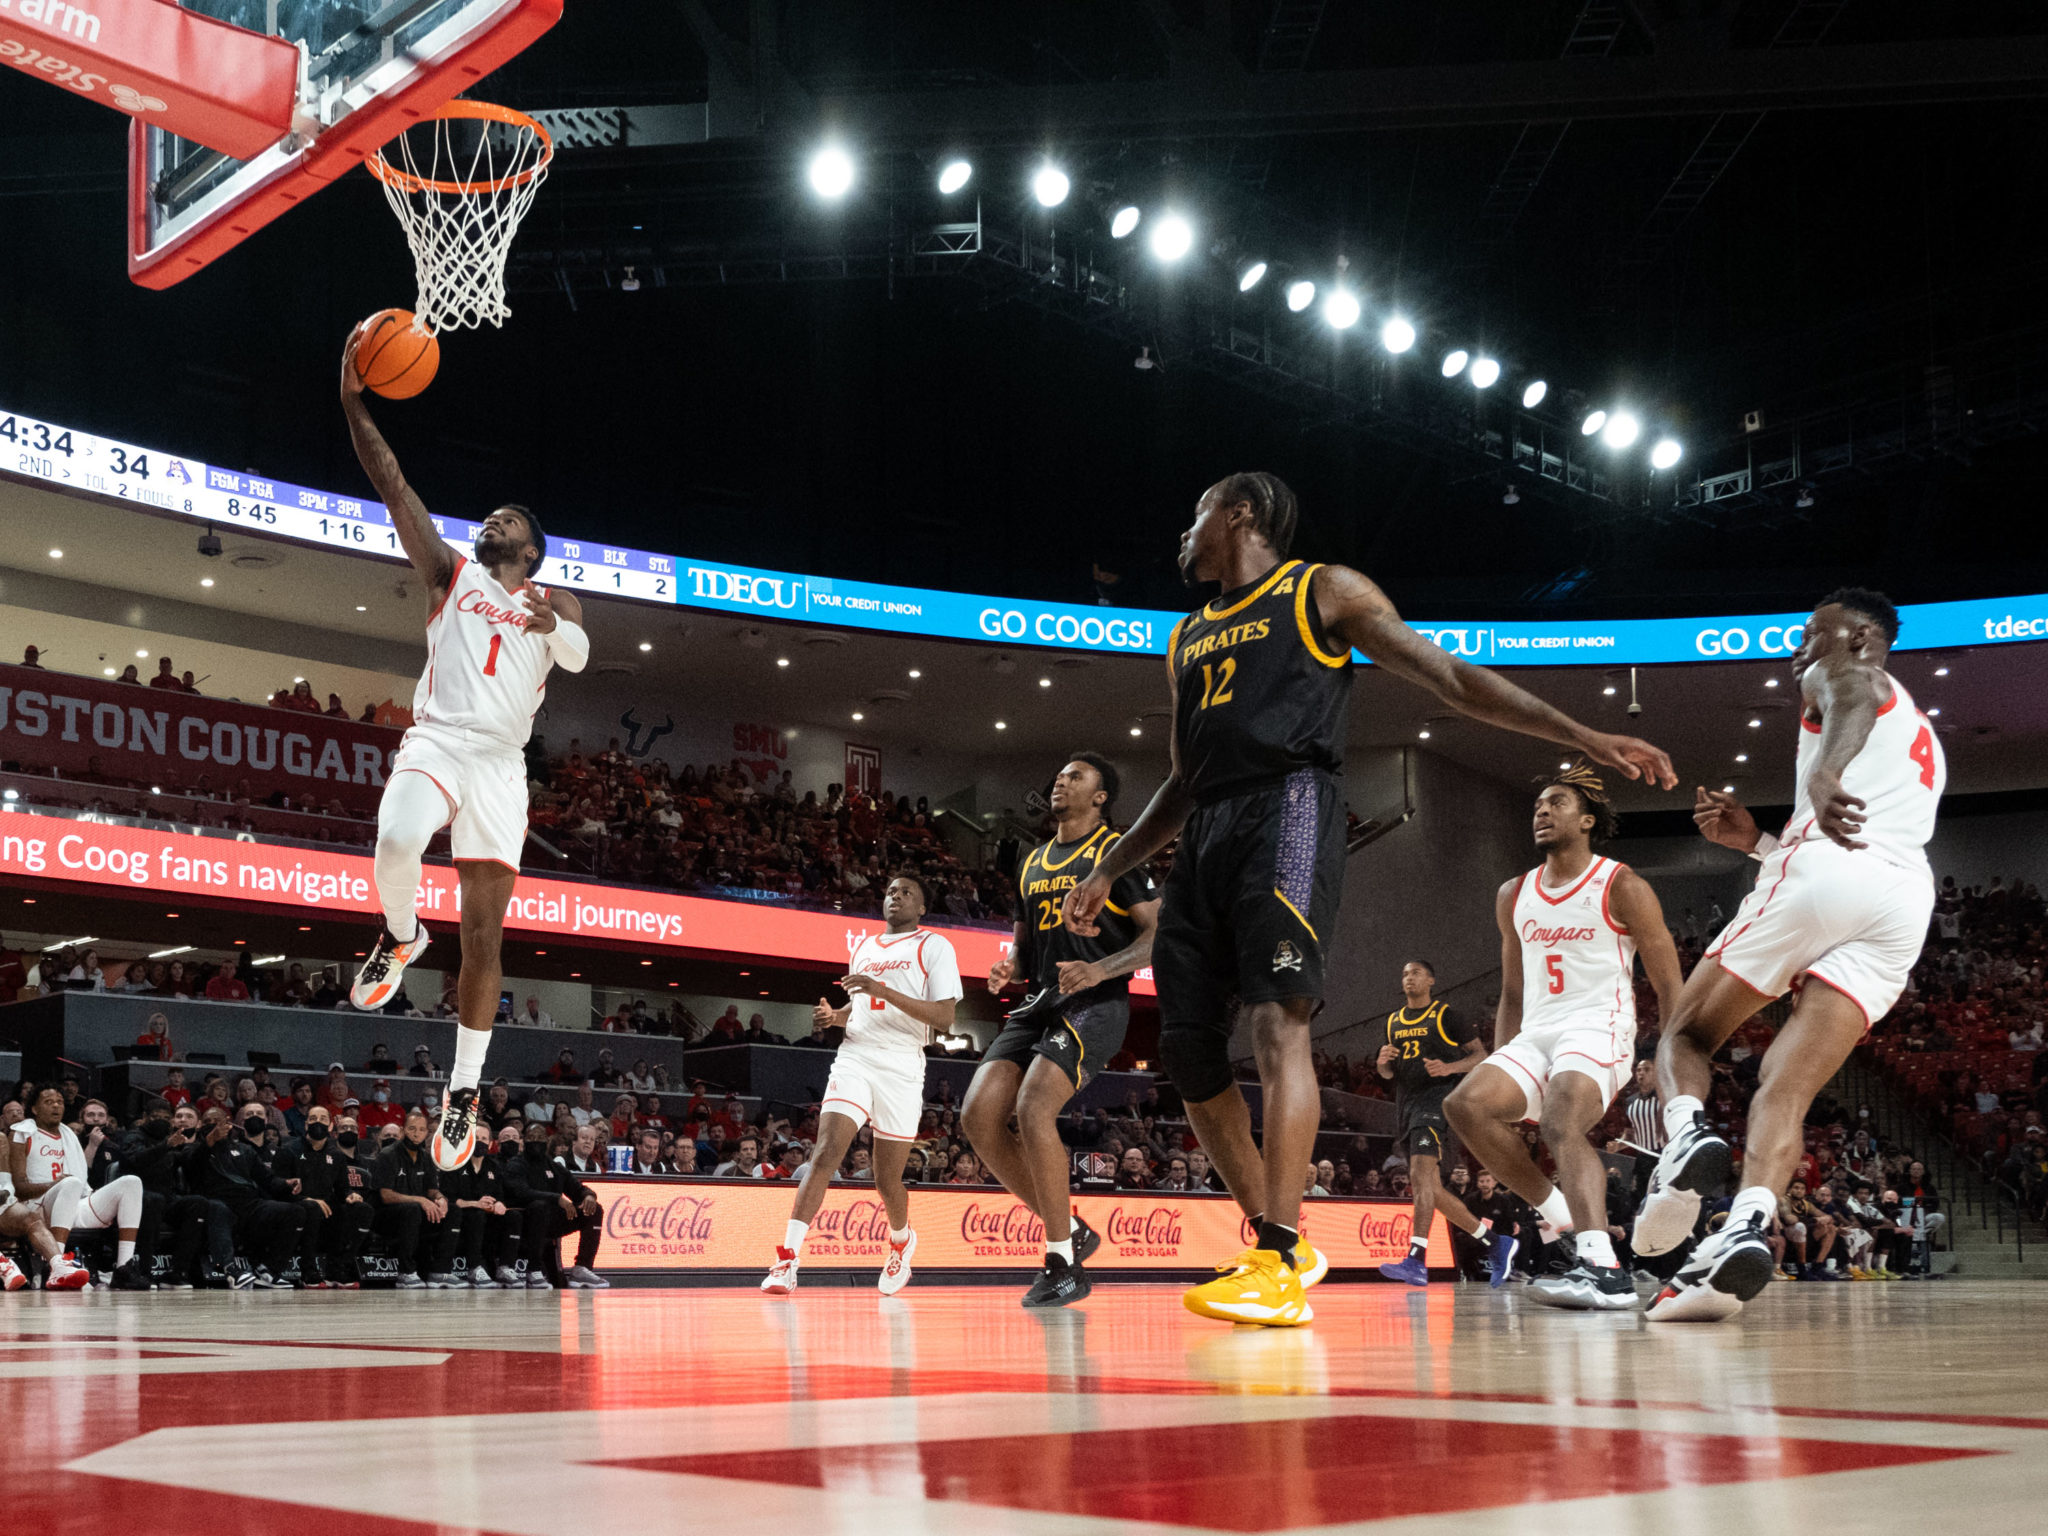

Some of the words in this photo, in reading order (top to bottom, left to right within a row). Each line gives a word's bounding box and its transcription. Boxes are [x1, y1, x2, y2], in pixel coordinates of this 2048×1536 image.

[19, 453, 53, 477] 2ND
[109, 447, 150, 480] 34
[118, 483, 128, 497] 2
[184, 499, 193, 512] 8
[563, 542, 581, 559] TO
[603, 549, 628, 566] BLK
[560, 563, 584, 582] 12
[649, 556, 671, 573] STL
[612, 572, 621, 587] 1
[656, 579, 667, 595] 2
[687, 567, 802, 609] TDECU
[811, 592, 842, 608] YOUR
[844, 597, 881, 613] CREDIT
[883, 601, 922, 616] UNION
[978, 608, 1027, 638] GO
[1035, 613, 1153, 649] COOGS!
[1983, 615, 2048, 639] tdec
[1182, 618, 1271, 667] PIRATES
[1497, 637, 1528, 649] YOUR
[1531, 637, 1570, 649] CREDIT
[1573, 636, 1615, 648] UNION
[1695, 627, 1750, 656] GO
[483, 634, 501, 677] 1
[1201, 657, 1237, 710] 12
[733, 723, 788, 760] SMU
[1909, 725, 1936, 791] 4
[58, 834, 149, 884] Coog
[160, 846, 228, 886] fans
[239, 863, 369, 902] navigate
[573, 896, 683, 940] journeys
[1028, 875, 1079, 895] PIRATES
[1038, 897, 1063, 931] 25
[1522, 919, 1595, 949] Cougars
[856, 957, 912, 977] Cougars
[1545, 955, 1564, 994] 5
[1394, 1027, 1429, 1040] PIRATES
[1402, 1040, 1420, 1060] 23
[606, 1195, 714, 1242] Coca-Cola
[1108, 1207, 1183, 1245] Coca-Cola
[621, 1244, 656, 1255] ZERO
[661, 1244, 705, 1255] SUGAR
[809, 1244, 840, 1255] ZERO
[844, 1245, 883, 1255] SUGAR
[974, 1246, 1002, 1256] ZERO
[1005, 1246, 1040, 1256] SUGAR
[1119, 1247, 1145, 1257] ZERO
[1147, 1248, 1178, 1257] SUGAR
[1369, 1249, 1390, 1258] ZERO
